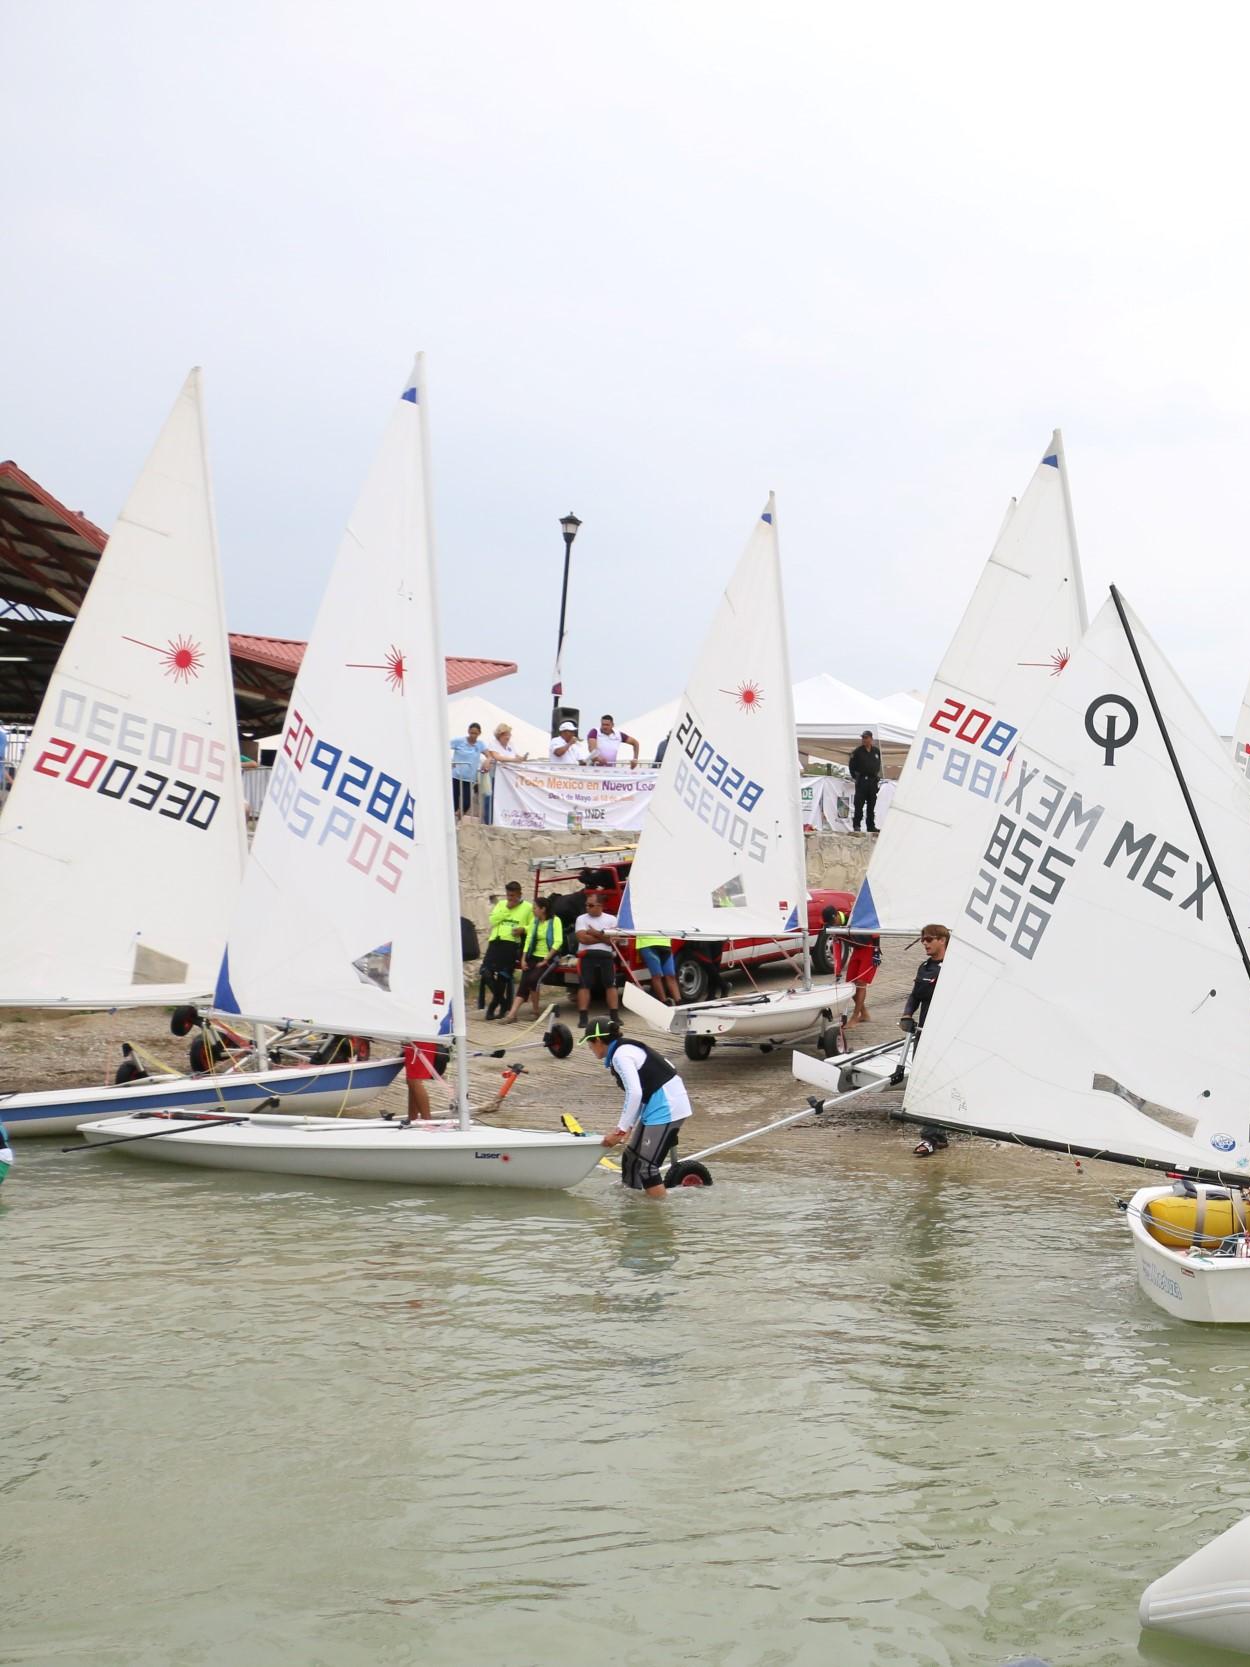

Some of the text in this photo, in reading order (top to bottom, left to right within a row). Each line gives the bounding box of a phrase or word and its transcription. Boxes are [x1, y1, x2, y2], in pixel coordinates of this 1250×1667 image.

[676, 712, 764, 812] 200328
[929, 698, 1018, 758] 208
[33, 737, 222, 831] 200330
[282, 709, 416, 840] 209288
[601, 780, 633, 792] Nuevo
[983, 814, 1076, 905] 855
[1103, 820, 1216, 921] MEX
[474, 1151, 501, 1159] Laser
